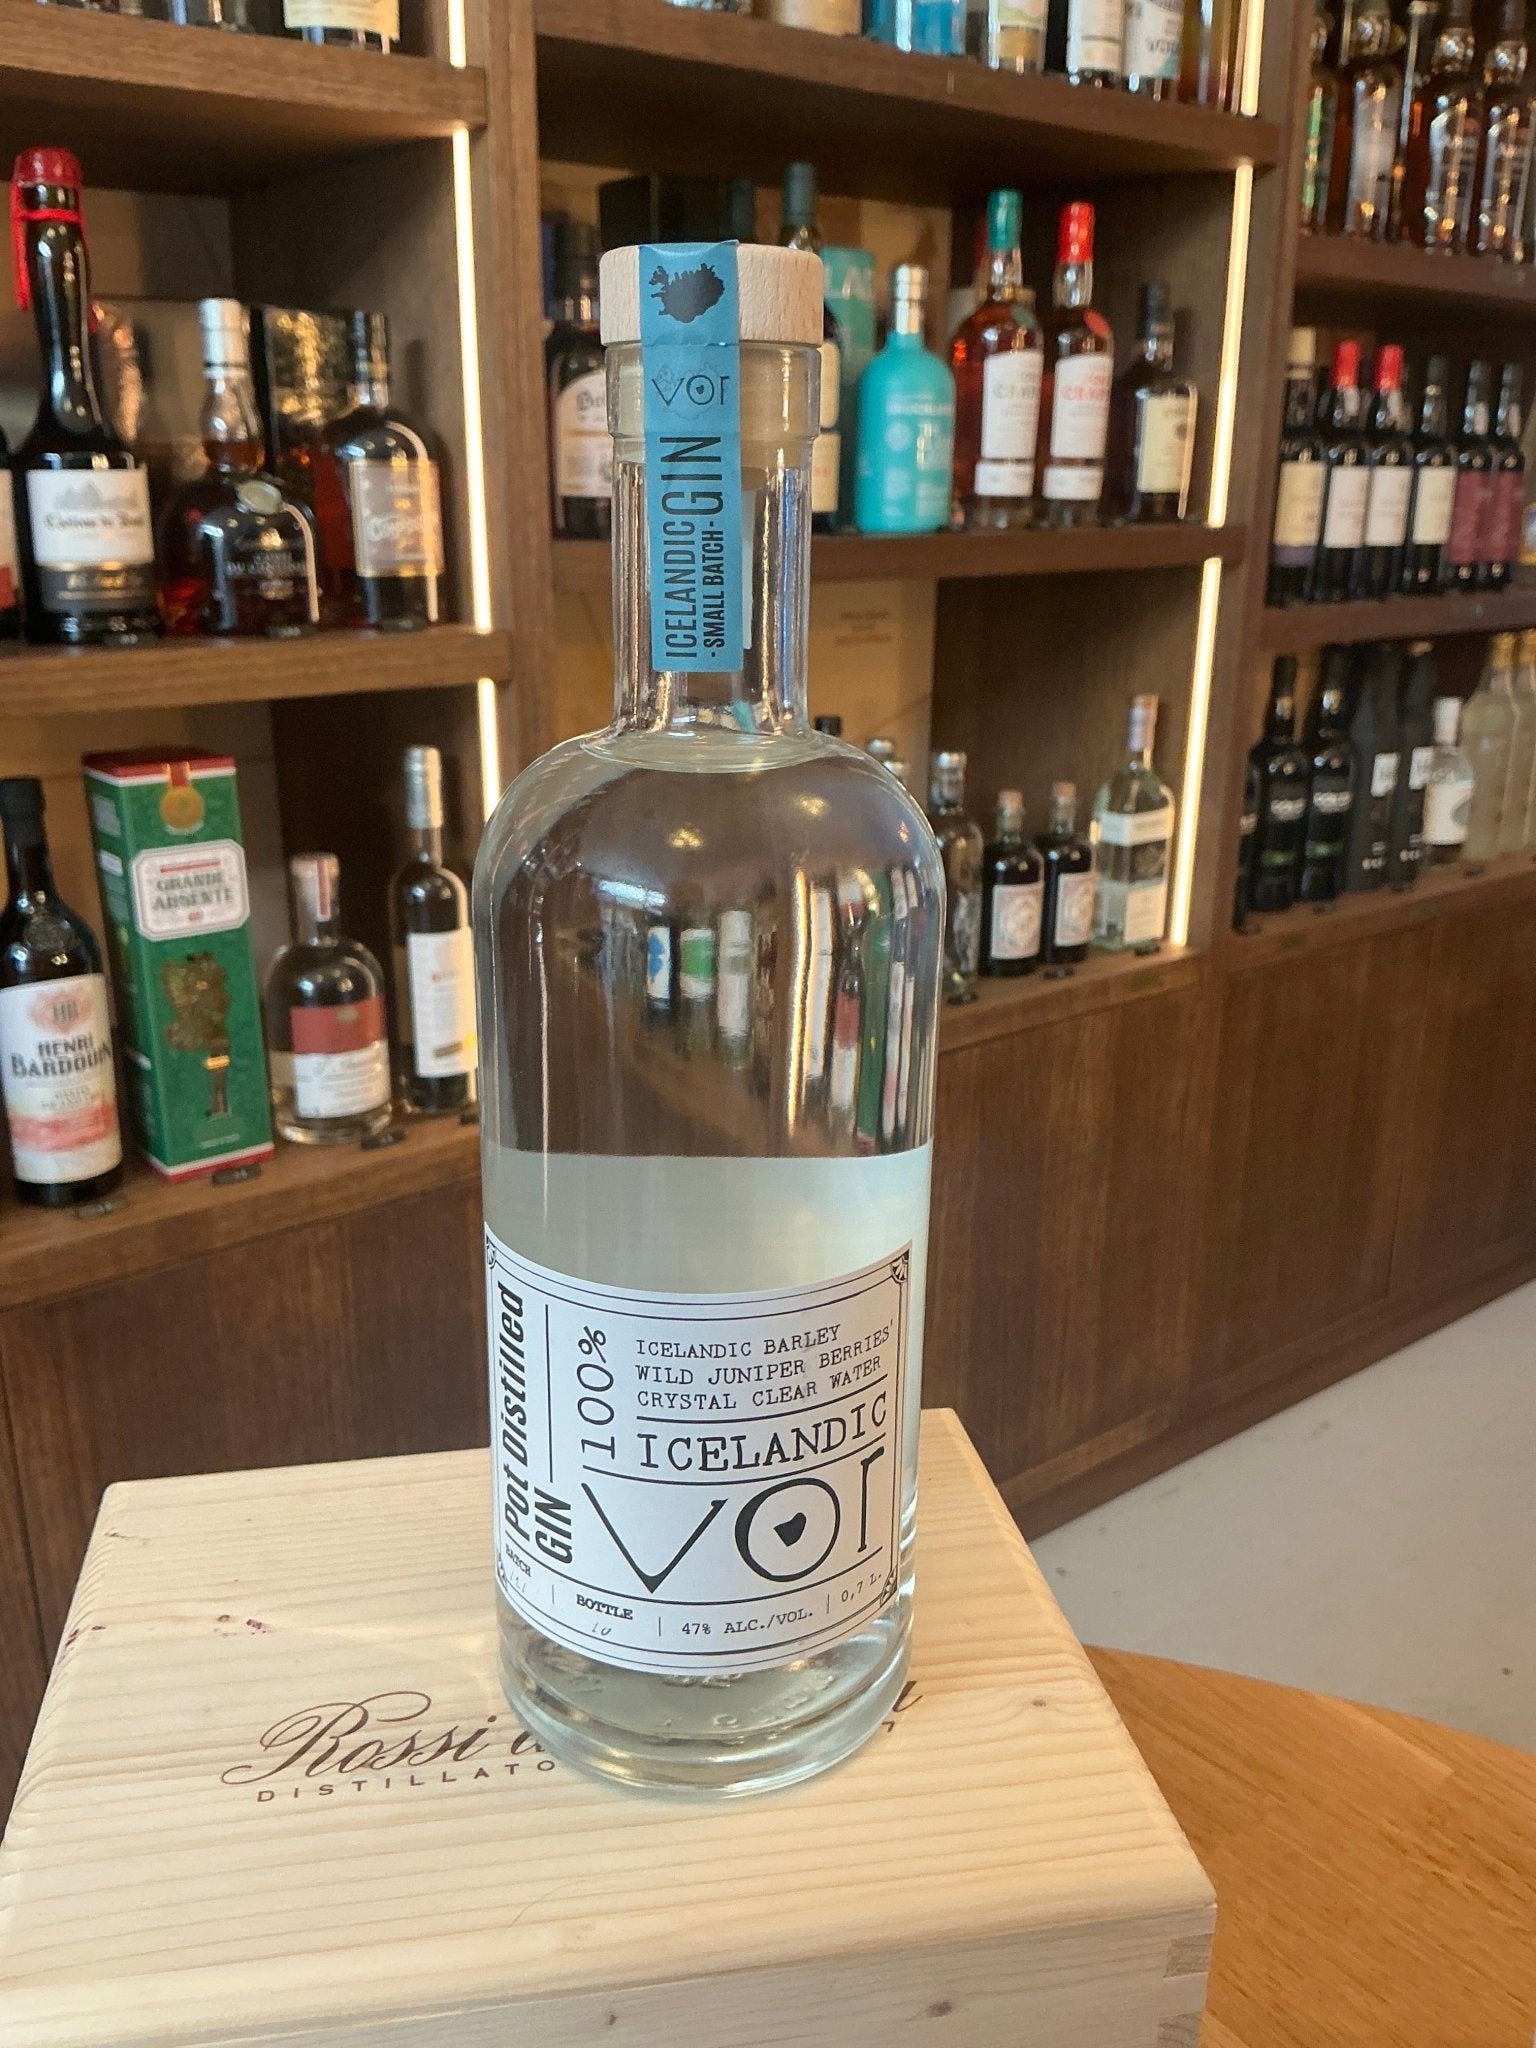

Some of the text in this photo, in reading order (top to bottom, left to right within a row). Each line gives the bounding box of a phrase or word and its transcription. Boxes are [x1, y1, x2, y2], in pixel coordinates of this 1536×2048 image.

[660, 436, 725, 658] ICELANDIC GIN
[701, 530, 726, 649] SMALL BATCH
[634, 1364, 694, 1386] WILD
[707, 1358, 806, 1386] JUNIPER
[635, 1323, 842, 1360] ICELANDIC BARLEY
[498, 1280, 531, 1543] Pot Distilled
[576, 1325, 616, 1461] 100%
[636, 1355, 882, 1411] CRYSTAL CLEAR WATER
[636, 1391, 888, 1473] ICELANDIC
[505, 1543, 532, 1578] BATCH
[534, 1486, 574, 1565] GIN
[575, 1593, 634, 1621] BOTTLE
[681, 1608, 814, 1635] 47% ALC./VOL.
[221, 1691, 498, 1786] Rossi
